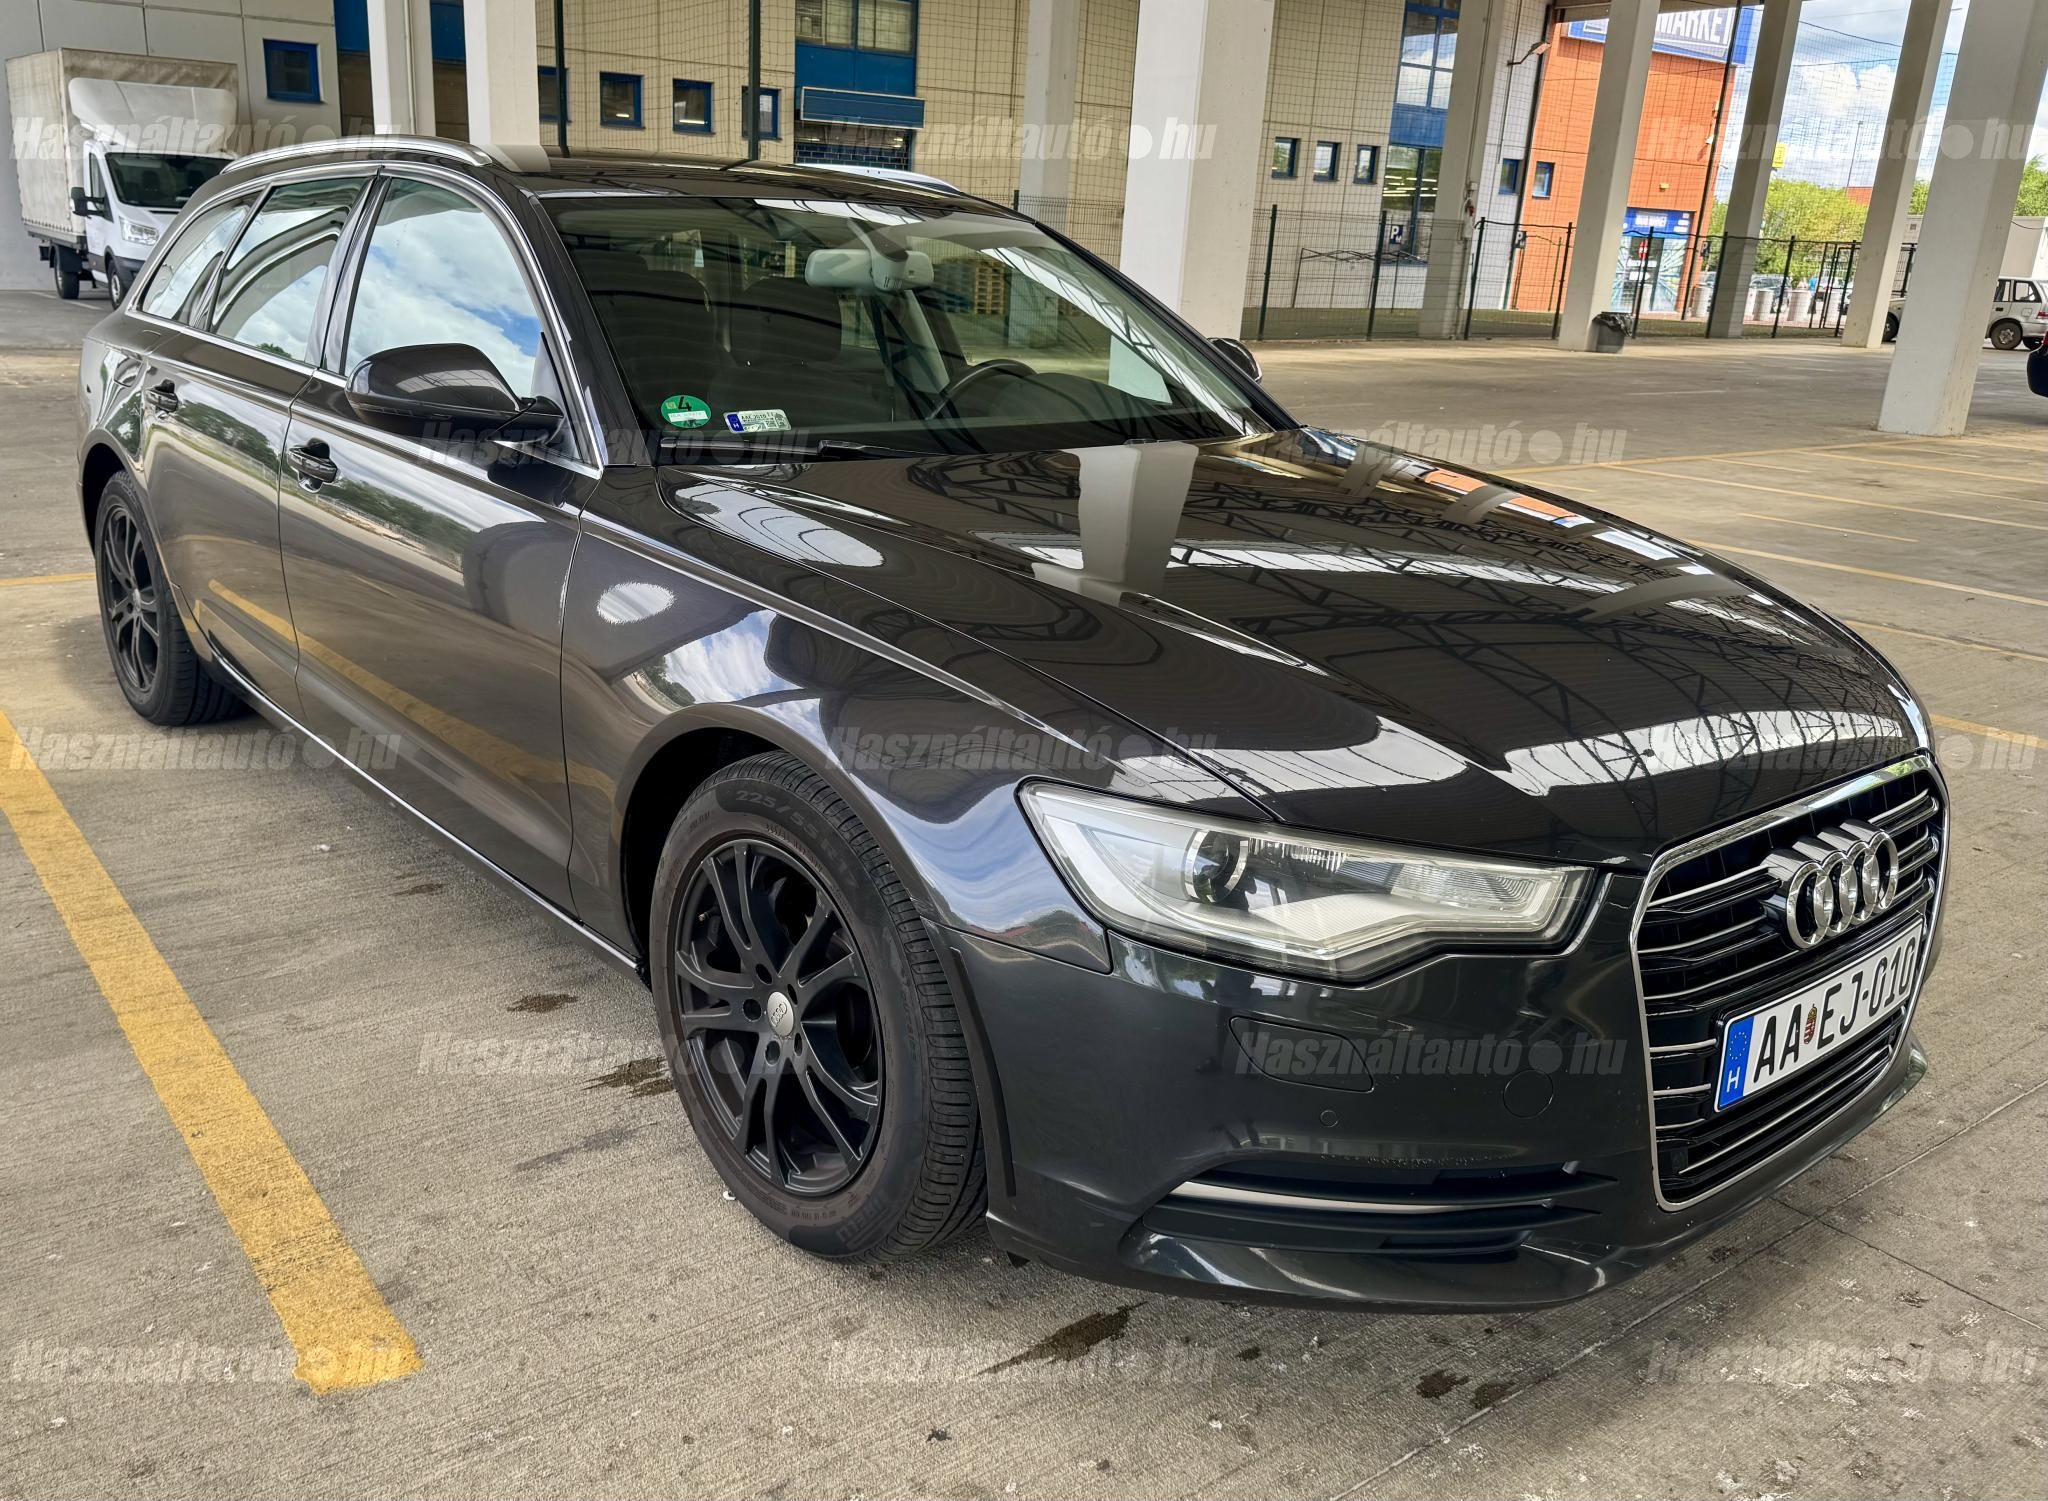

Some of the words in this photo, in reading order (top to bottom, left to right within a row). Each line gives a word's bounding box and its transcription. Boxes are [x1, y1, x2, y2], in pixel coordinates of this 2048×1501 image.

[677, 396, 692, 411] 4
[1753, 1003, 1802, 1084] AA
[1817, 936, 1916, 1050] EJ-010
[1726, 1069, 1740, 1093] H
